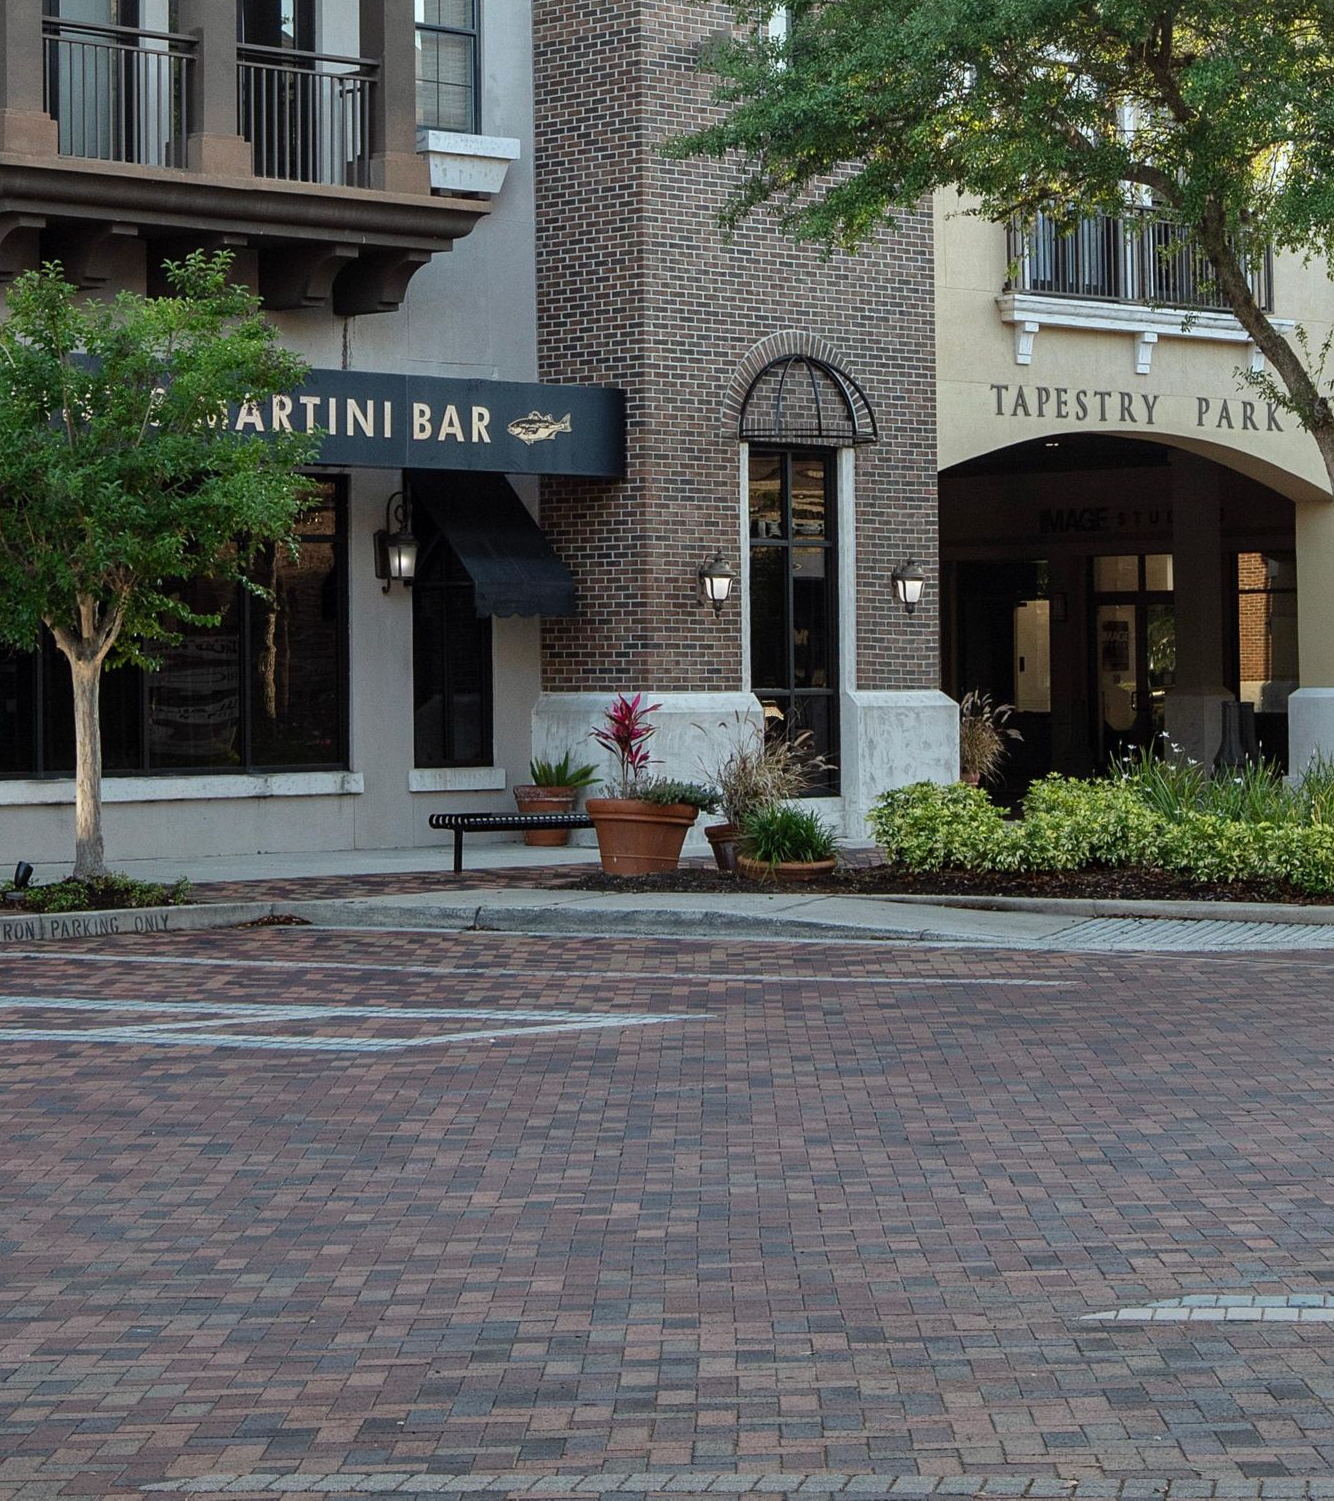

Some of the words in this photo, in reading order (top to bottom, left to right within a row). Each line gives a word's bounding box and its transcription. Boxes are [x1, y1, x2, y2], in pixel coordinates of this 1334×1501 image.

[412, 402, 492, 444] BAR
[990, 384, 1161, 425] TAPESTRY
[1196, 397, 1284, 433] PARK
[1038, 507, 1108, 534] IMAGE
